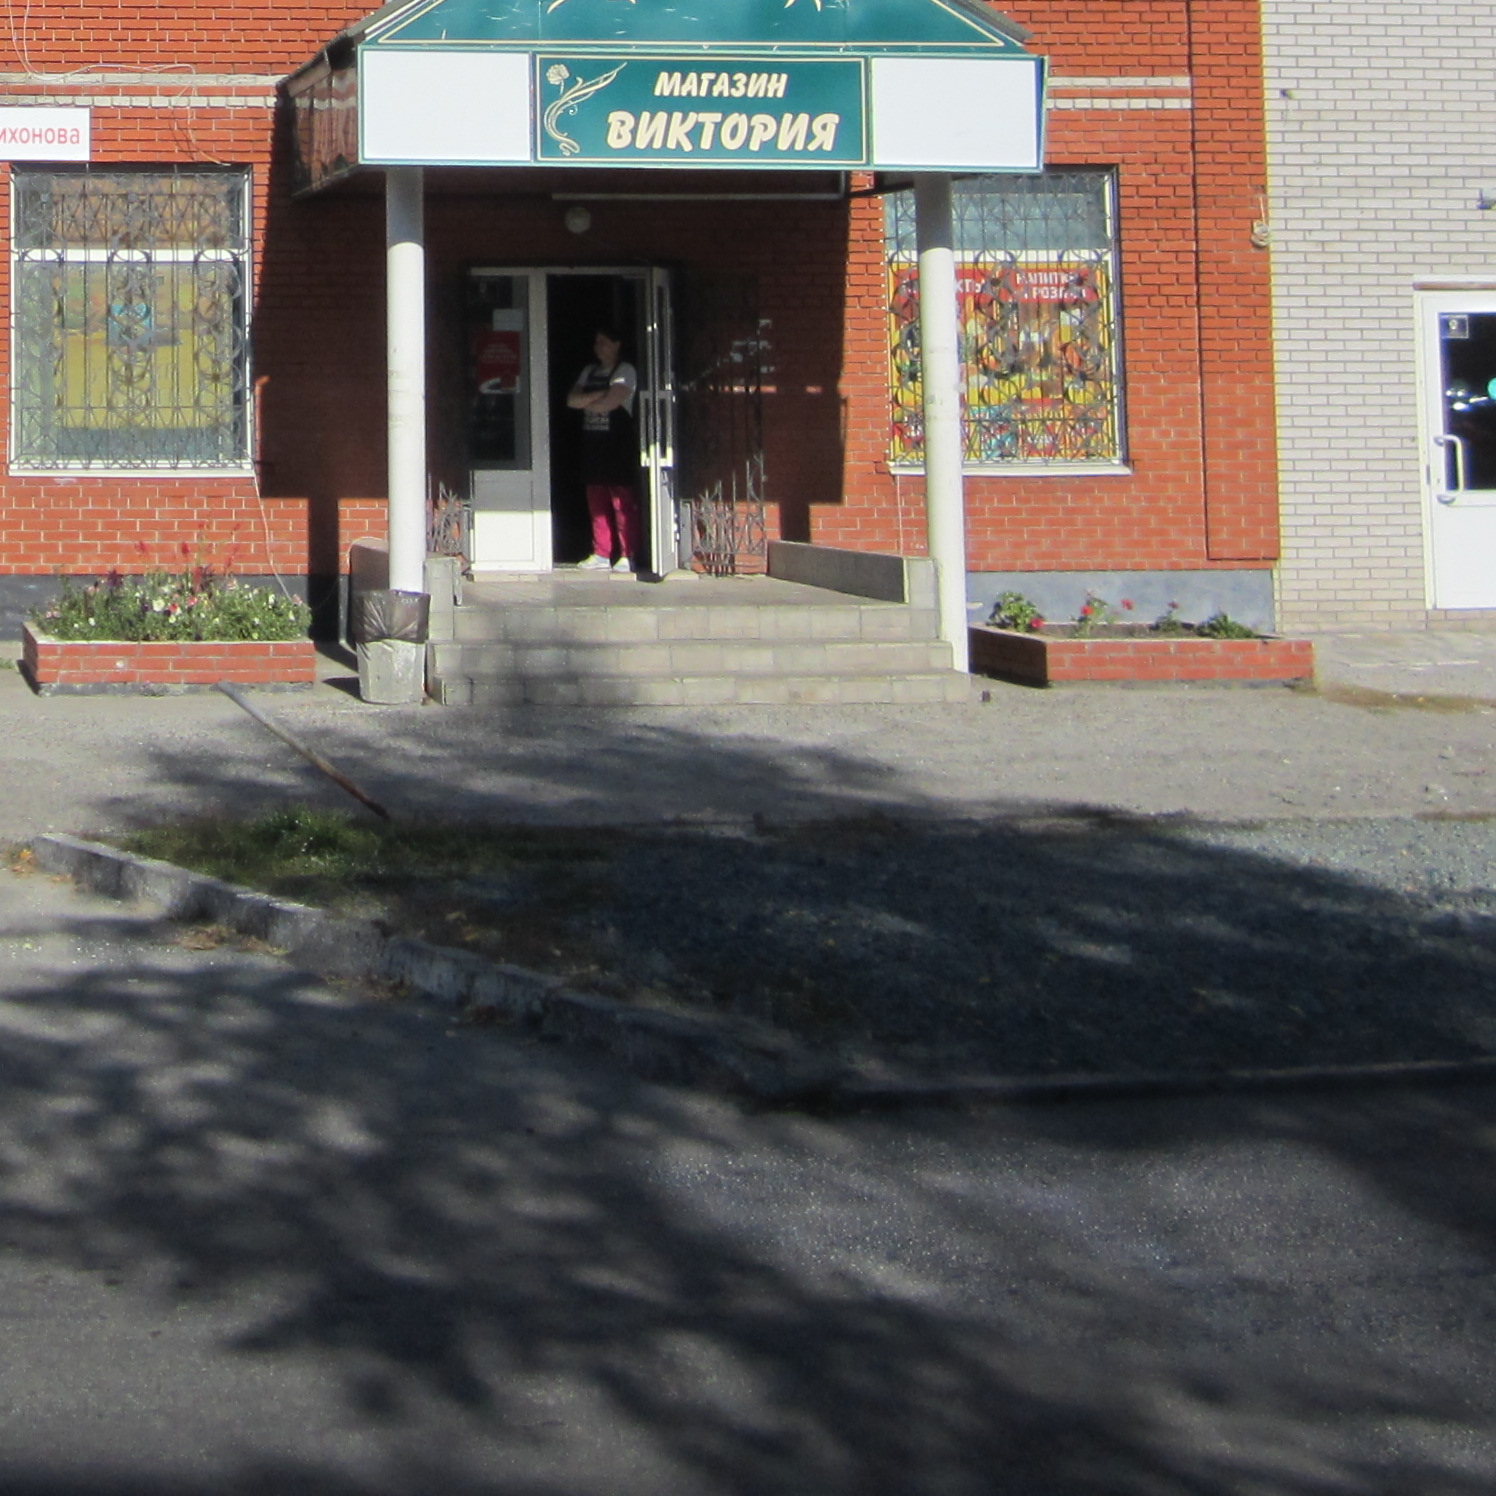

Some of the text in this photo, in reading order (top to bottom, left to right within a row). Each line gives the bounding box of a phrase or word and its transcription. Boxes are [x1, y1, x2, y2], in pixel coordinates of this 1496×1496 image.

[653, 71, 789, 99] МАГАЗИН
[606, 110, 841, 153] ВИКТОРИЯ
[1016, 271, 1075, 285] НАПИТК
